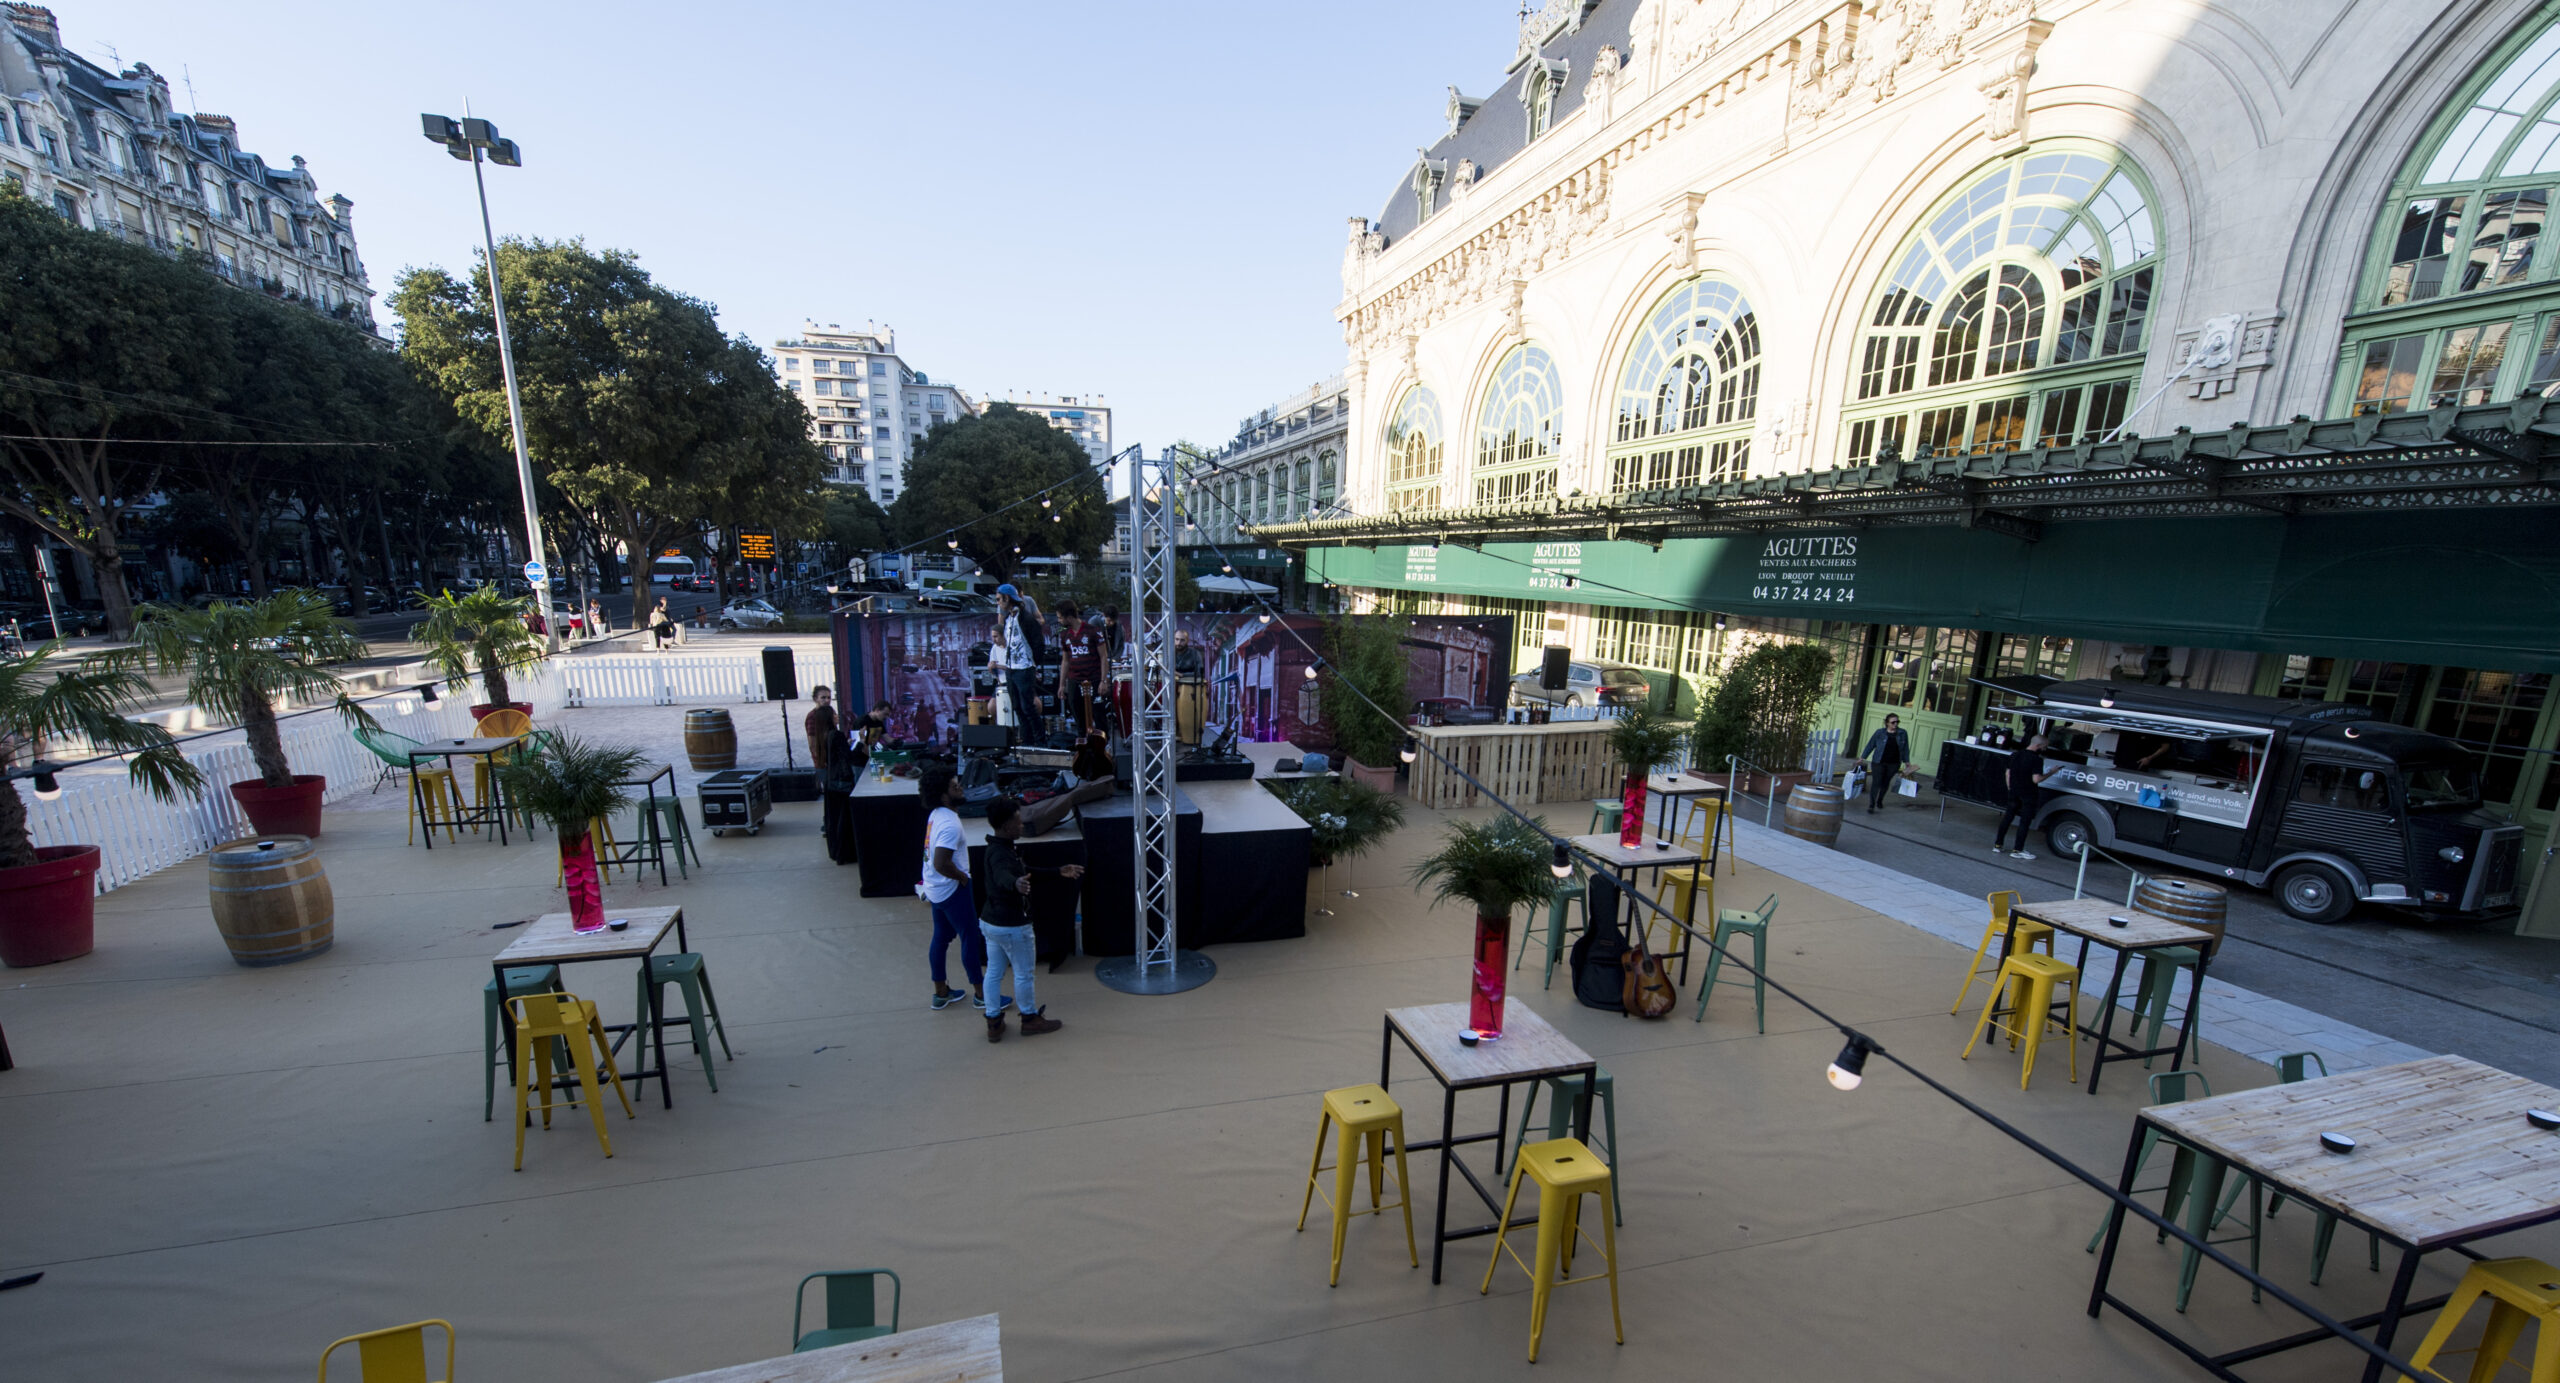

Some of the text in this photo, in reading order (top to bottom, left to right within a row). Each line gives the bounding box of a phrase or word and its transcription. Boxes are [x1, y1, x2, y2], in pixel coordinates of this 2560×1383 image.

[1533, 543, 1581, 557] AGUTTES
[1763, 536, 1858, 557] AGUTTES
[1760, 558, 1857, 567] VENTES AUX ENCHERES
[1529, 577, 1538, 587] 04
[1539, 577, 1548, 588] 37
[1549, 578, 1558, 588] 24
[1758, 572, 1856, 581] LYON DROUOT NEUILLY
[1753, 586, 1855, 602] 04 37 24 24 24
[1070, 643, 1089, 655] bs2
[2187, 791, 2206, 802] sind
[2207, 796, 2221, 804] ein
